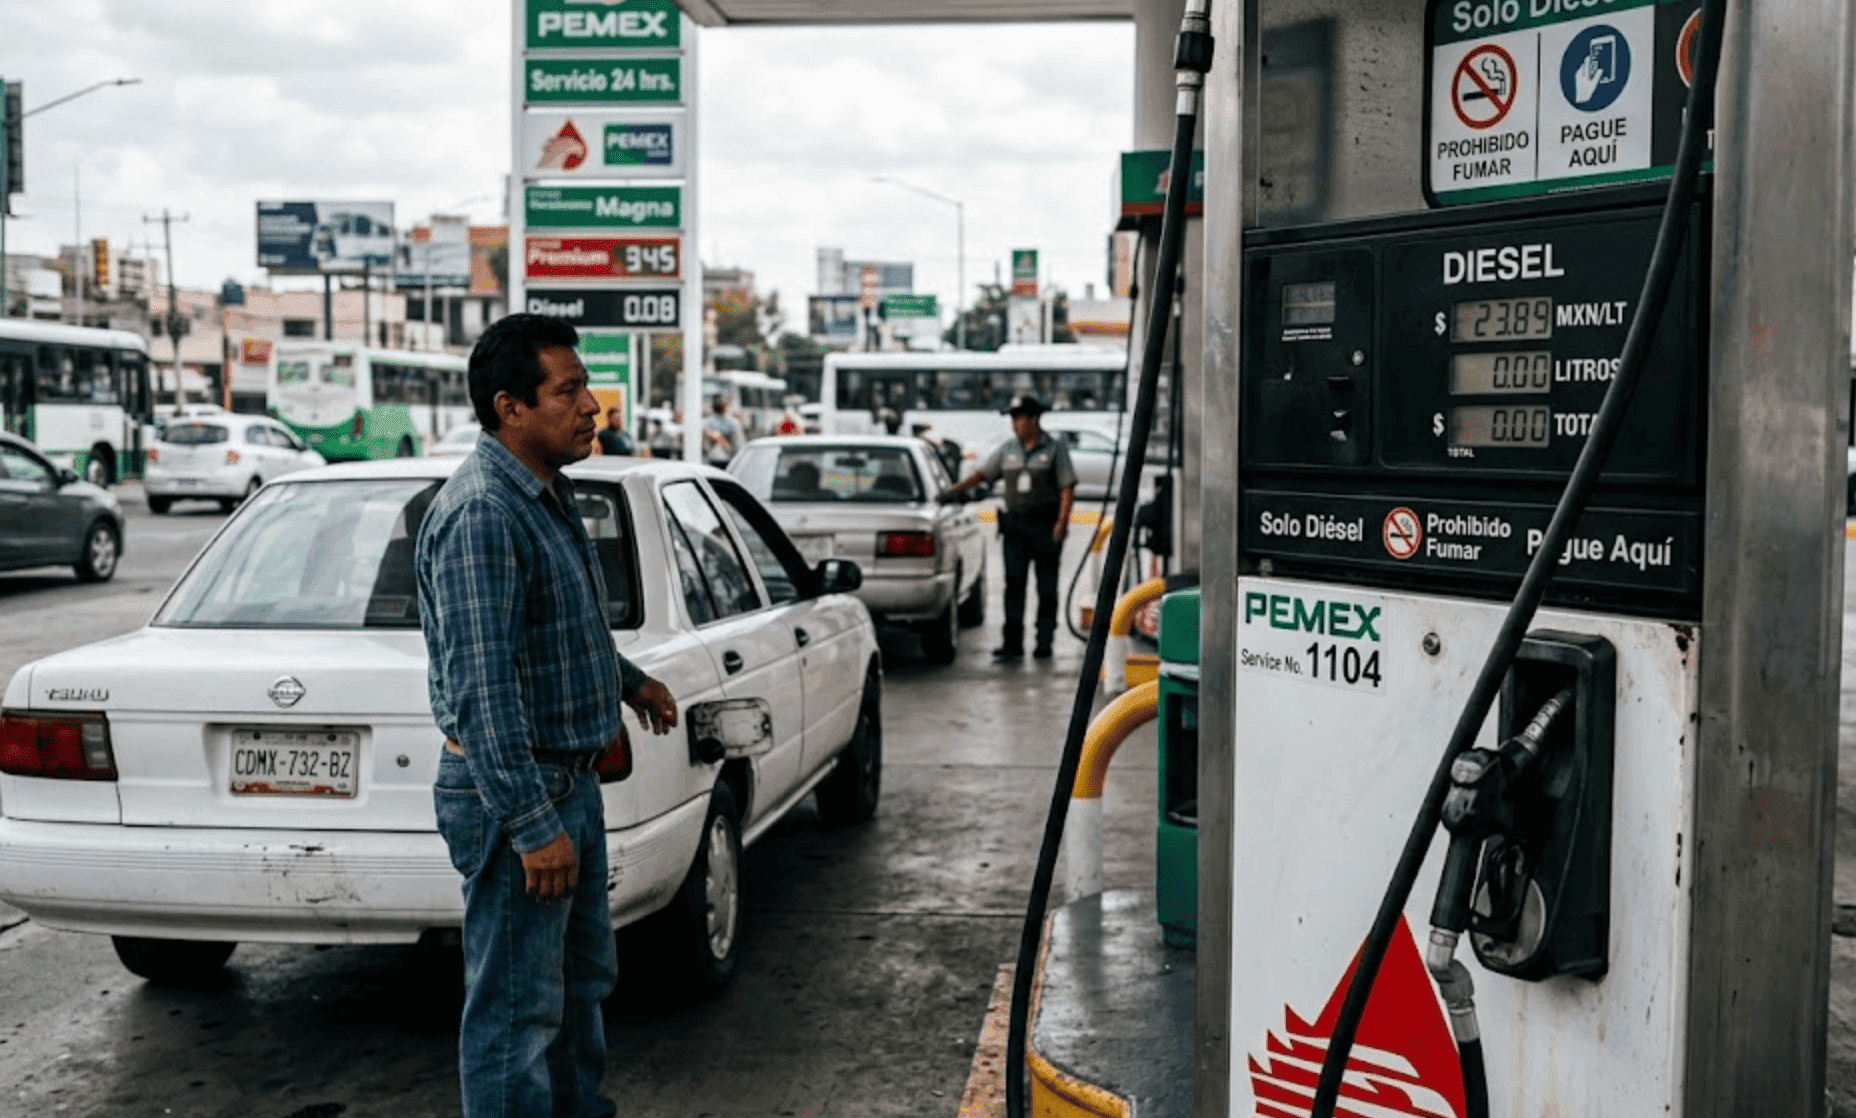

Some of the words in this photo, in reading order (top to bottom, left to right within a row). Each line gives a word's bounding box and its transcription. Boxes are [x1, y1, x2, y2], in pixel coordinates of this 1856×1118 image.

[538, 11, 667, 37] PEMEX
[1453, 0, 1519, 33] Solo
[531, 68, 607, 91] Servicio
[610, 68, 635, 91] 24
[639, 69, 675, 91] hrs.
[607, 132, 668, 149] PEMEX
[1437, 130, 1530, 160] PROHIBIDO
[1561, 118, 1626, 144] PAGUE
[1569, 138, 1618, 168] AQUÍ
[1453, 158, 1511, 181] FUMAR
[595, 196, 674, 223] Magna
[1443, 243, 1565, 285] DIESEL
[1434, 311, 1447, 336] $
[1474, 300, 1549, 337] 23.89
[1556, 301, 1627, 327] MXN/LT
[1493, 355, 1548, 389] 0.00
[1555, 357, 1621, 382] LITROS
[1433, 412, 1445, 437] $
[1492, 410, 1547, 442] 0.00
[1260, 511, 1300, 537] Solo
[1305, 514, 1364, 542] Diésel
[1426, 512, 1512, 538] Prohibido
[1426, 537, 1482, 561] Fumar
[1527, 528, 1604, 566] Pgue
[1609, 534, 1675, 572] Aquí
[1245, 591, 1382, 643] PEMEX
[1241, 648, 1281, 672] Service
[1306, 642, 1382, 688] 1104
[235, 749, 351, 778] CDMX-732-BZ
